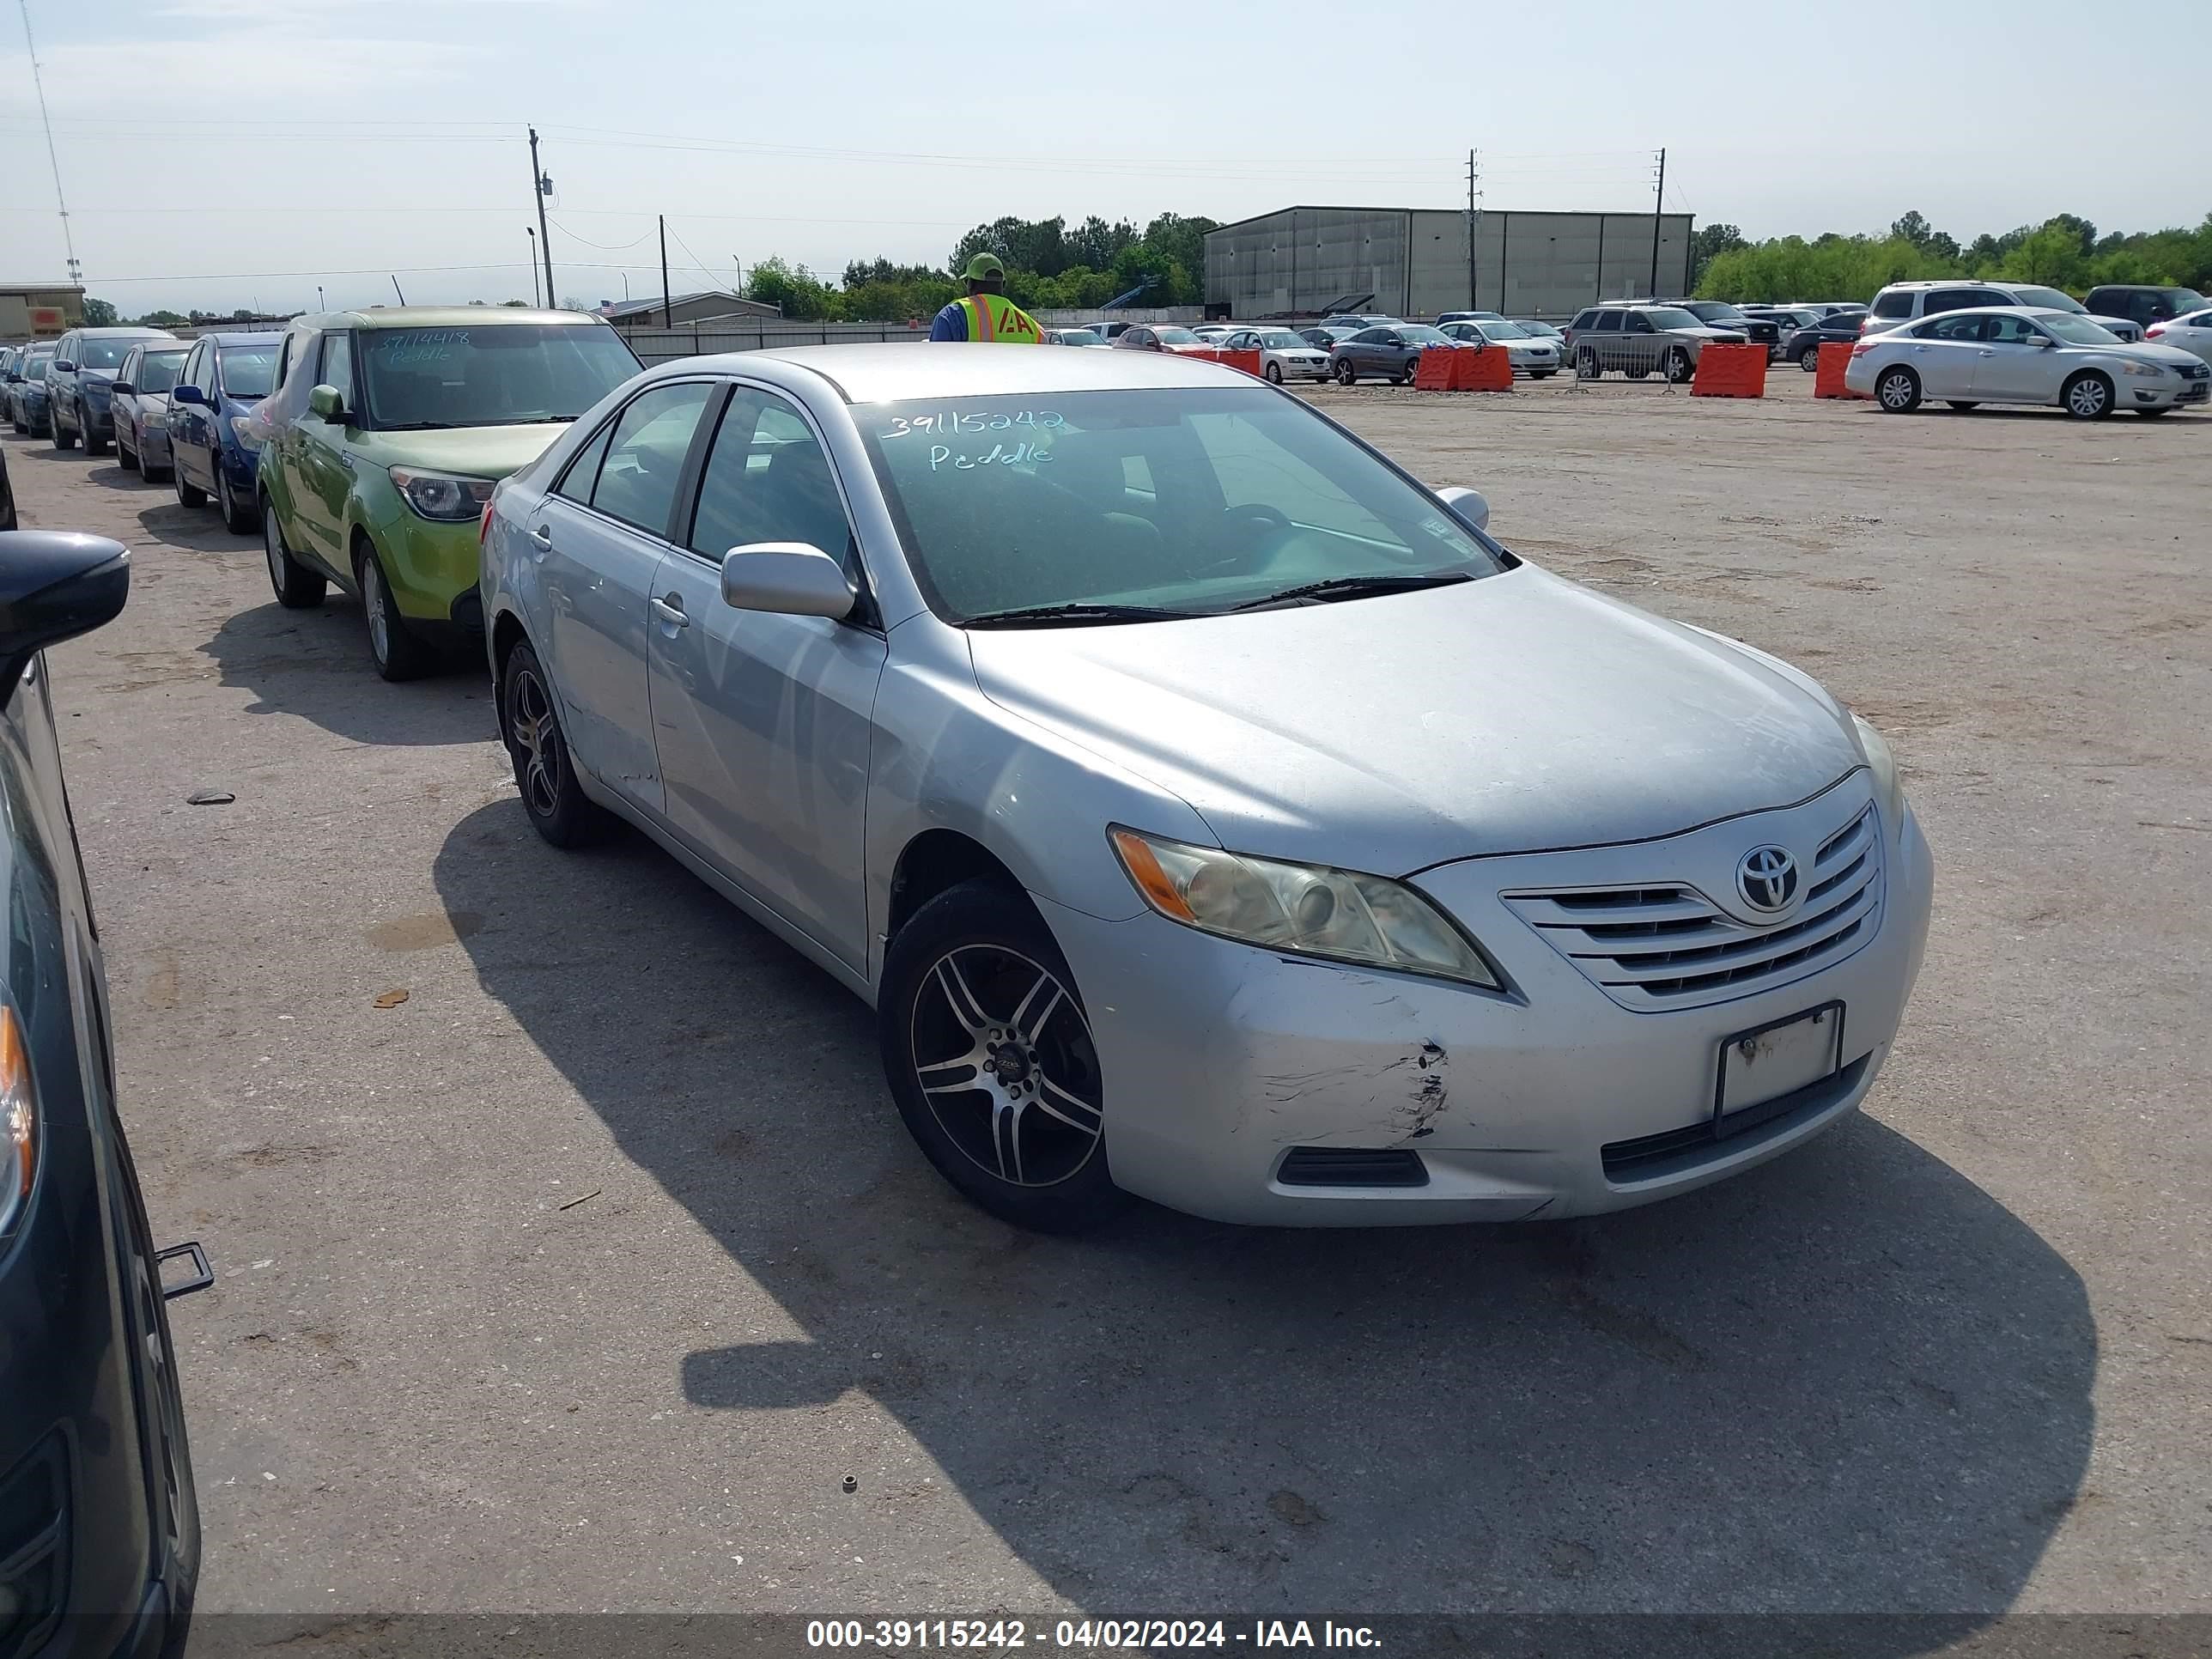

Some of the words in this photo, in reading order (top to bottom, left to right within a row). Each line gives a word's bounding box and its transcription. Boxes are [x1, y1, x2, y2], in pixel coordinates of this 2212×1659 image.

[379, 331, 470, 351] 39114418
[881, 410, 1065, 440] 39115242
[929, 441, 1054, 472] Peddle
